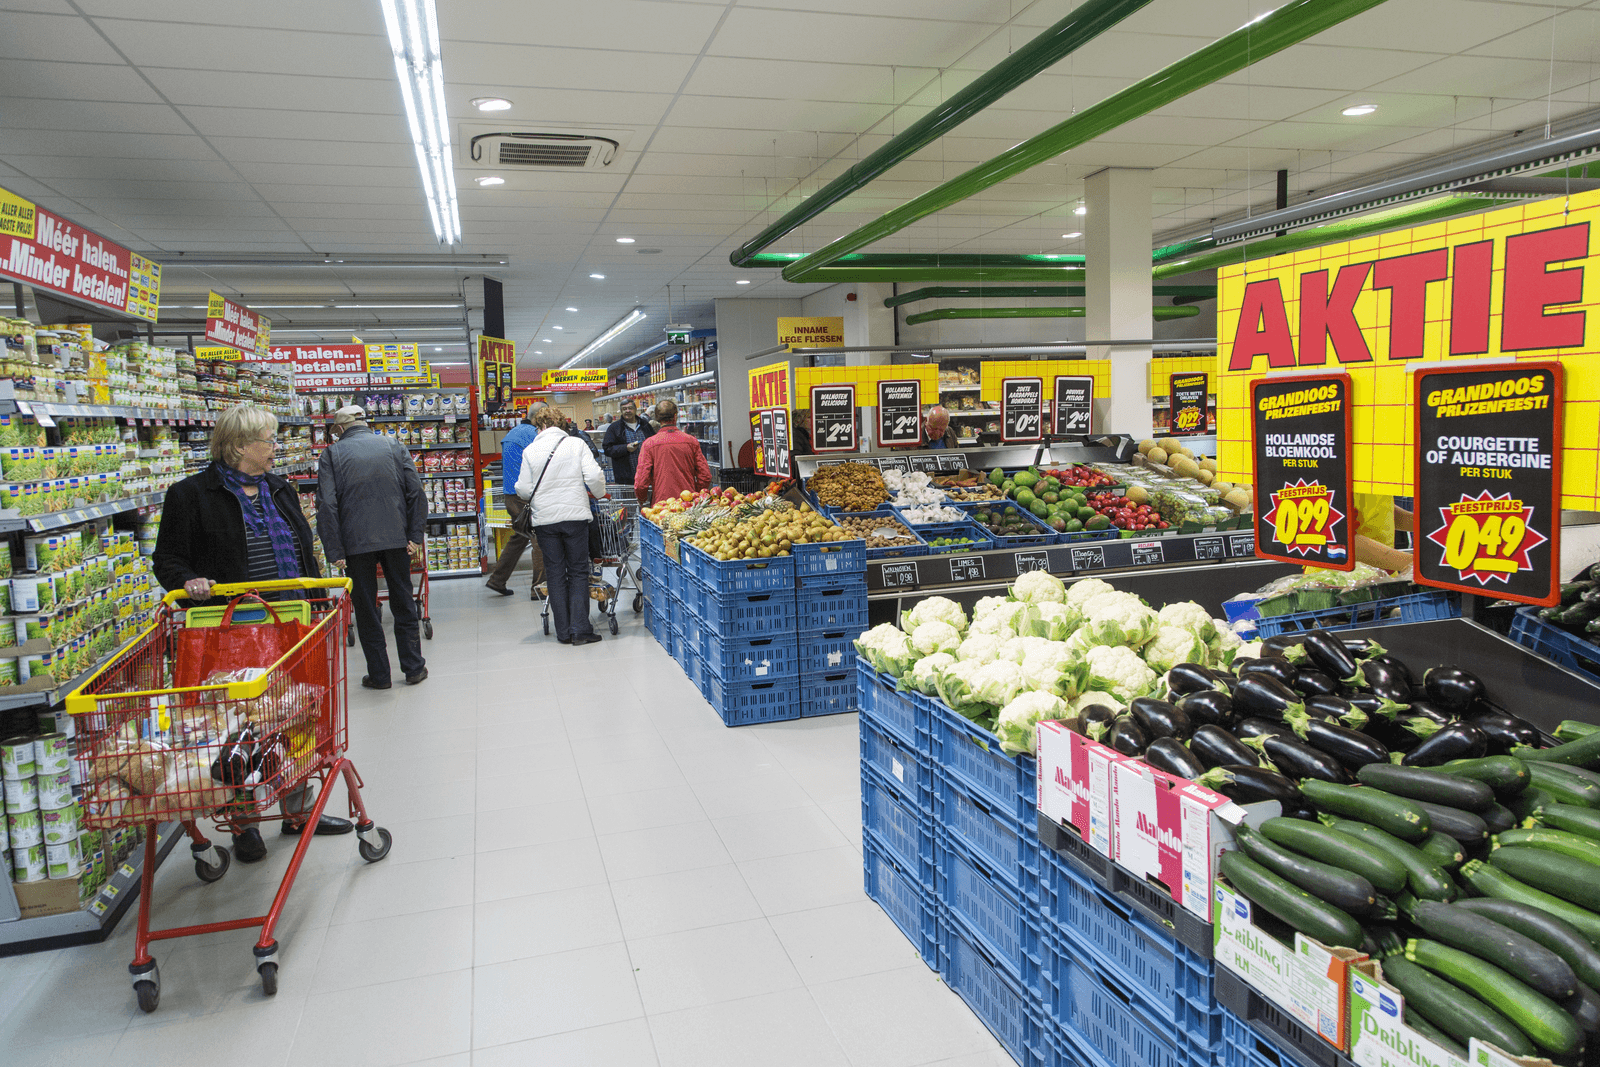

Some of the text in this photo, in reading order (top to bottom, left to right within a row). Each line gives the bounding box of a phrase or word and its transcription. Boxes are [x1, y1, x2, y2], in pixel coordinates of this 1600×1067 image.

[2, 202, 34, 220] ALLER ALLER
[37, 212, 128, 279] Méér halen...
[0, 239, 70, 289] .Minder
[73, 264, 127, 307] betalen!
[1228, 220, 1591, 372] AKTIE
[794, 326, 828, 334] INNAME
[780, 335, 843, 344] LEGE FLESSEN
[297, 347, 361, 360] halen...
[480, 340, 514, 364] AKTIE
[293, 360, 362, 373] betalen!
[751, 369, 787, 408] AKTIE
[1258, 384, 1338, 411] GRANDIOOS
[1426, 375, 1545, 407] GRANDIOOS
[1265, 400, 1341, 420] PRIJZENFEEST!
[1436, 394, 1549, 418] PRIJZENFEEST!
[1265, 433, 1335, 446] HOLLANDSE
[1437, 436, 1539, 453] COURGETTE
[1265, 445, 1337, 459] BLOEMKOOL
[1426, 450, 1551, 469] OF AUBERGINE
[1282, 459, 1319, 468] PER STUK
[1460, 466, 1513, 479] PER STUK
[1279, 485, 1326, 498] FEESTPRIJS
[1453, 500, 1522, 514] FEESTPRIJS
[1055, 766, 1089, 801] Mando
[1136, 811, 1182, 853] Mando
